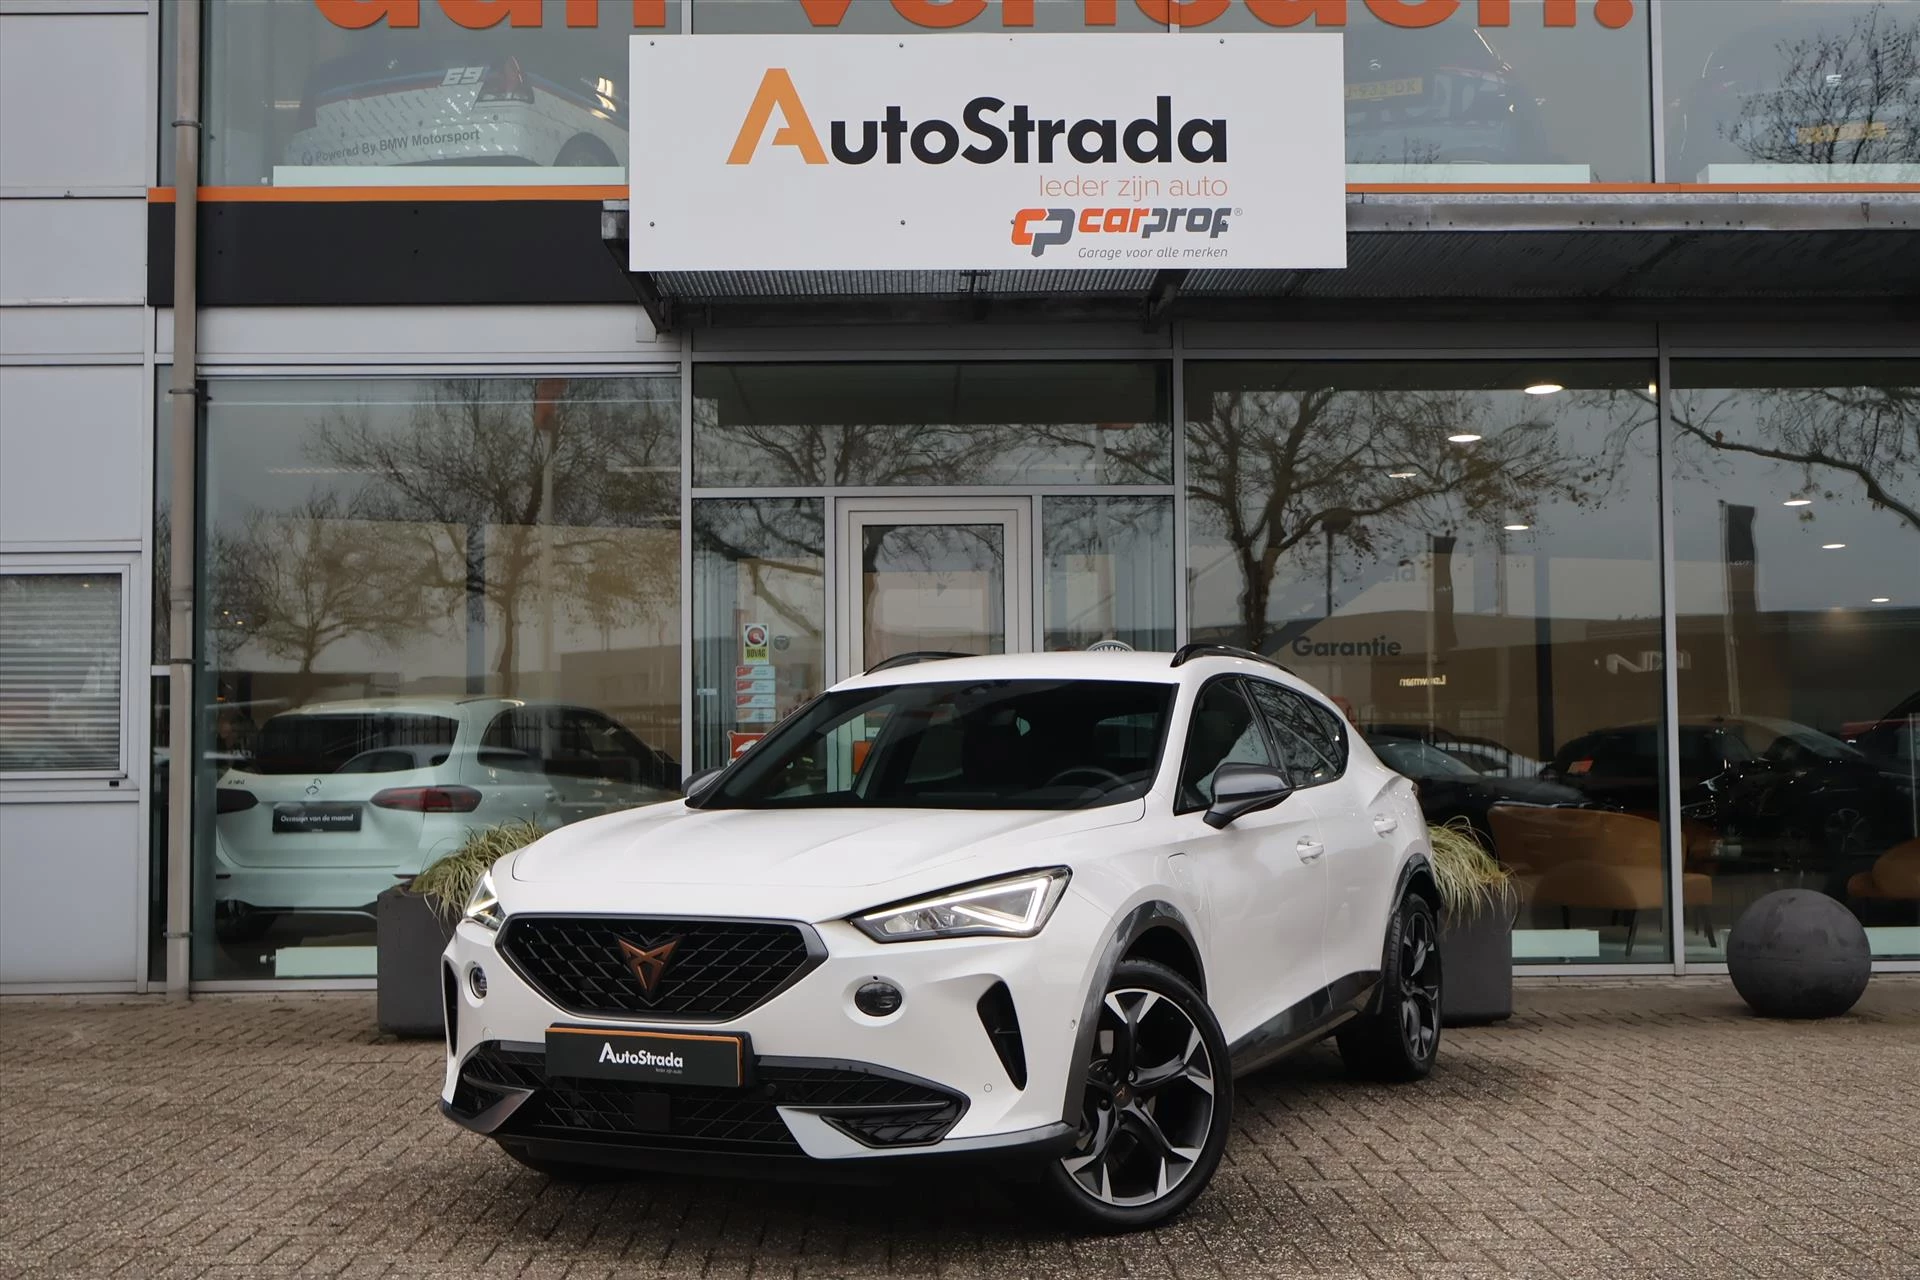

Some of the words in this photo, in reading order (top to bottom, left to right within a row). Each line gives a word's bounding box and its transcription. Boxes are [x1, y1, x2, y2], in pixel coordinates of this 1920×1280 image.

[442, 66, 484, 86] 69
[726, 67, 1227, 165] AutoStrada
[316, 146, 359, 163] Powered
[362, 142, 376, 156] By
[379, 136, 409, 152] BMW
[411, 129, 481, 149] Motorsport
[1039, 175, 1109, 197] Ieder
[1118, 176, 1160, 202] zijn
[1168, 178, 1228, 198] auto
[1078, 247, 1122, 261] Garage
[1126, 249, 1153, 258] voor
[1156, 247, 1181, 258] alle
[1183, 247, 1228, 258] merken
[1291, 635, 1403, 657] Garantie
[598, 1042, 684, 1068] AutoStrada
